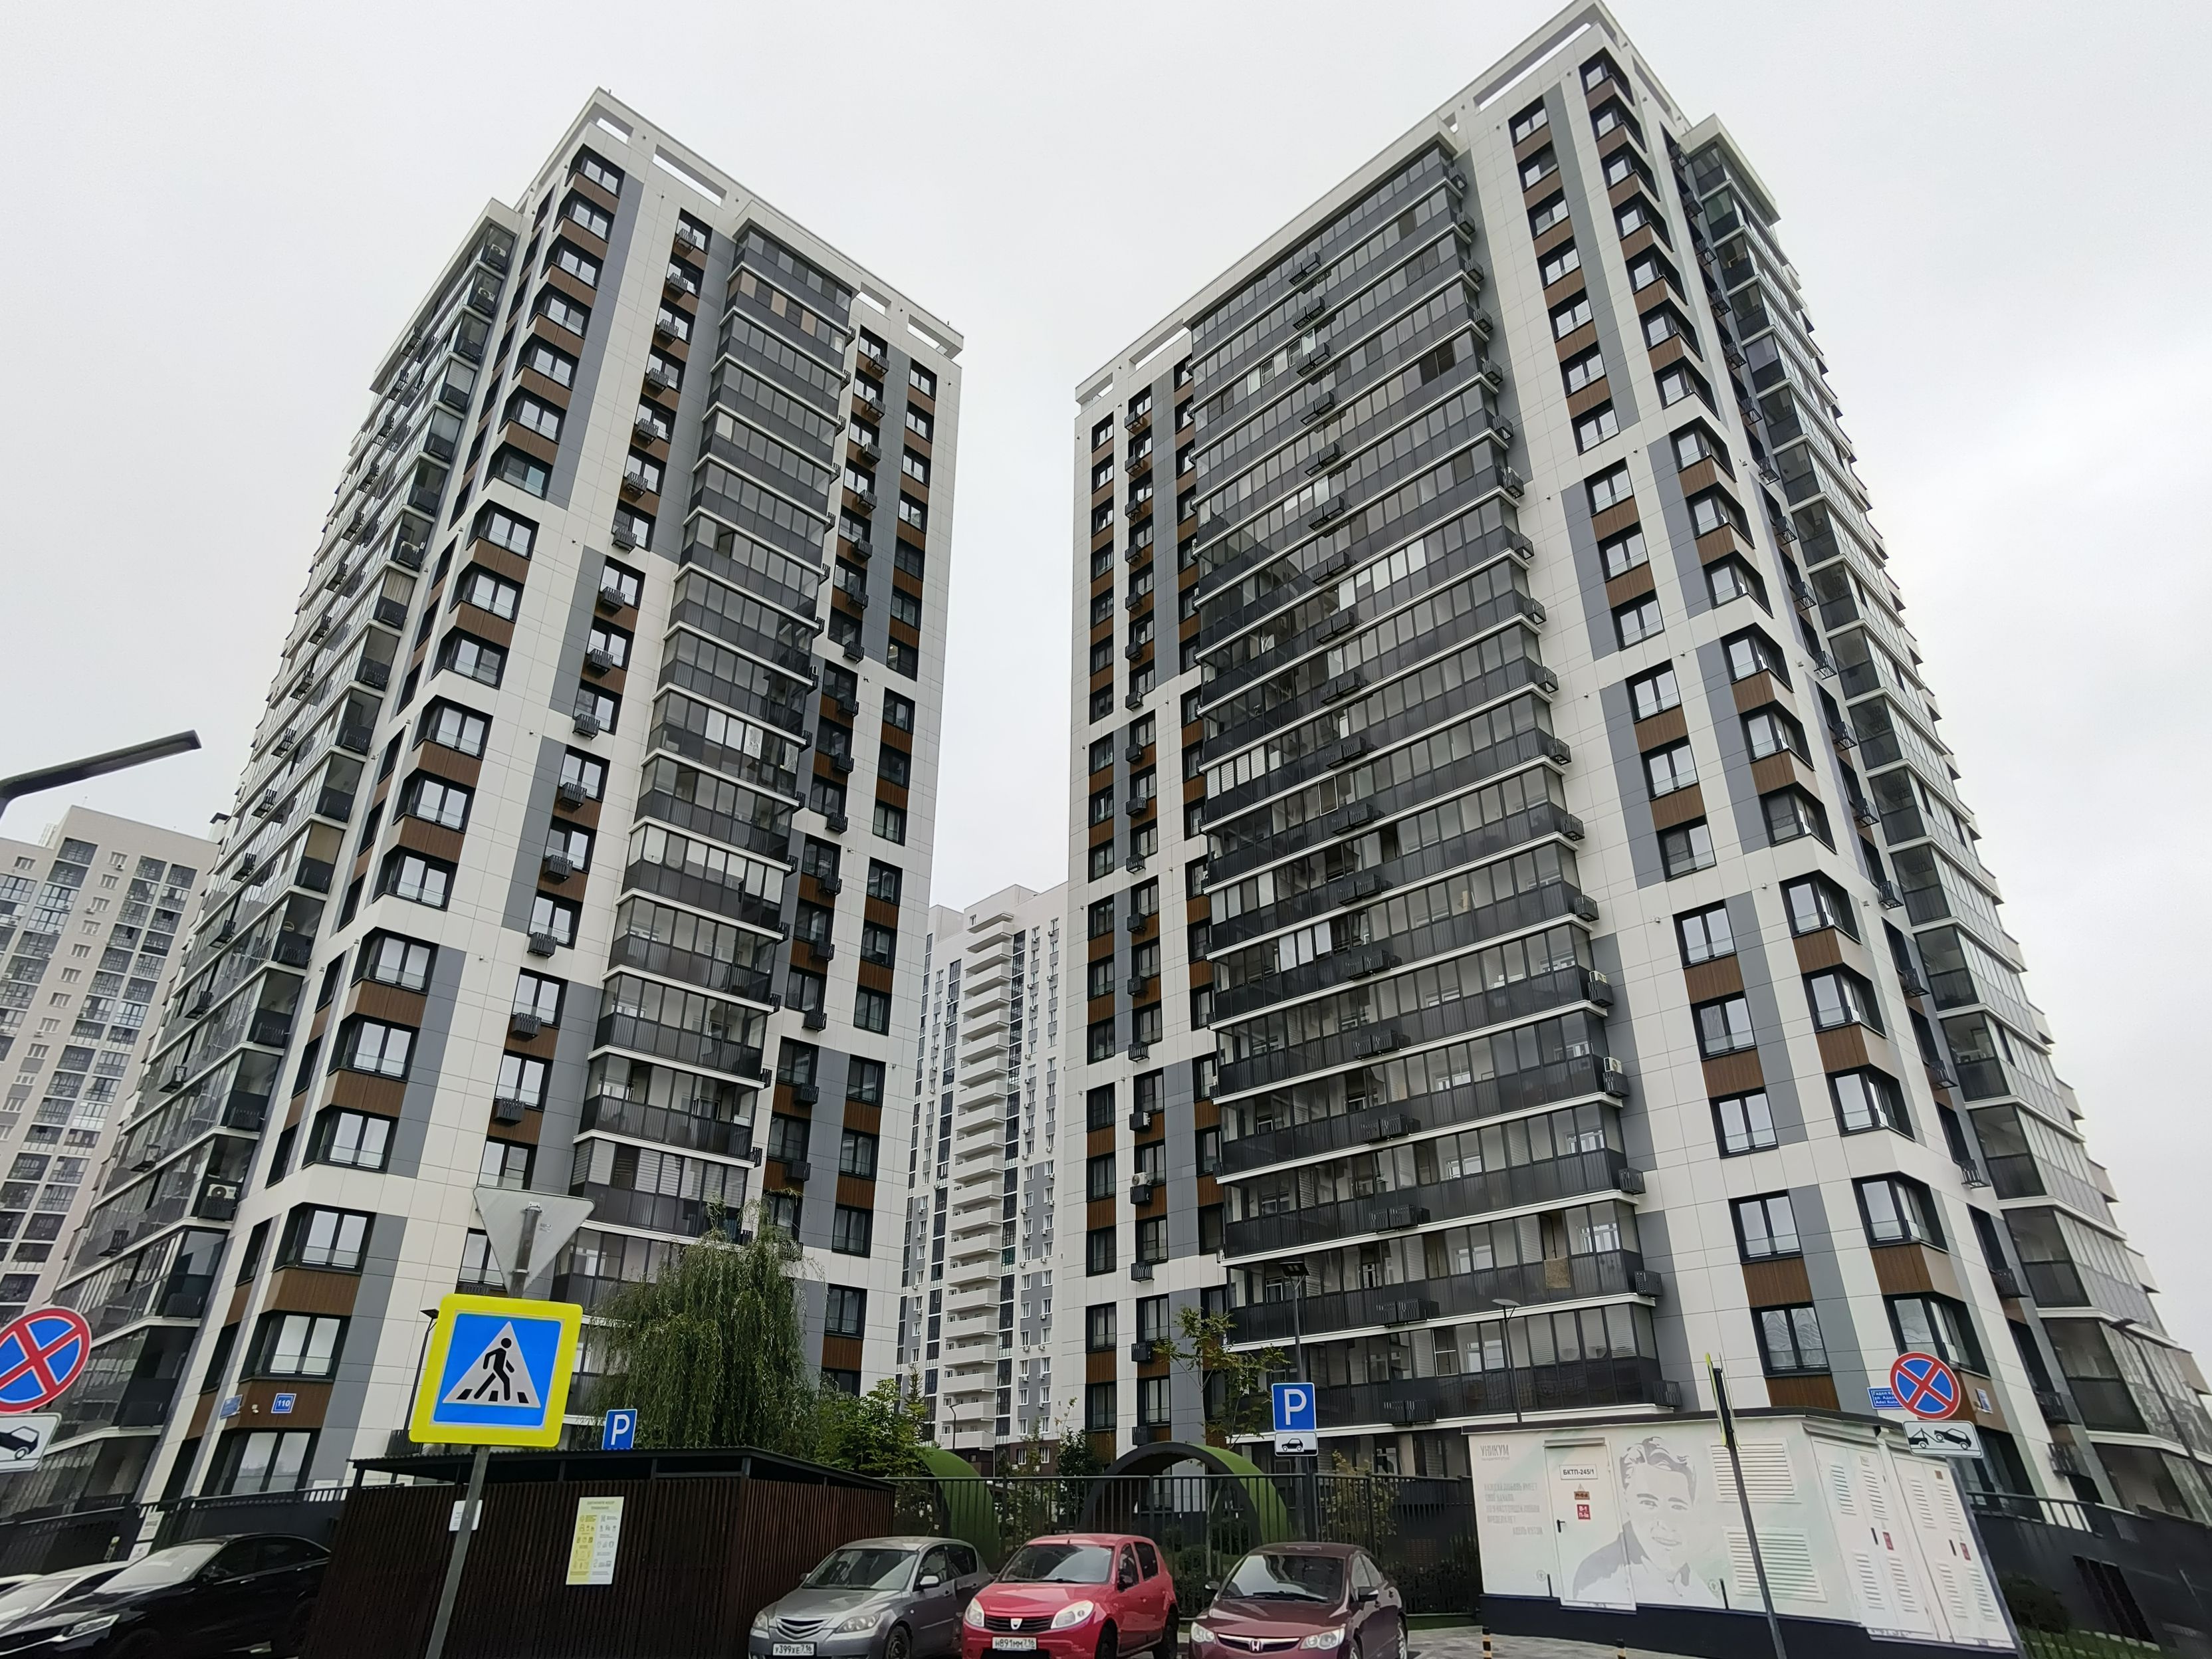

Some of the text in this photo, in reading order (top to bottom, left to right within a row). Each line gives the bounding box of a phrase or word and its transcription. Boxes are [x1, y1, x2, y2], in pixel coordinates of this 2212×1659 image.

[1284, 1389, 1307, 1425] P
[611, 1414, 630, 1445] P
[1480, 1444, 1509, 1456] УНИКУМ
